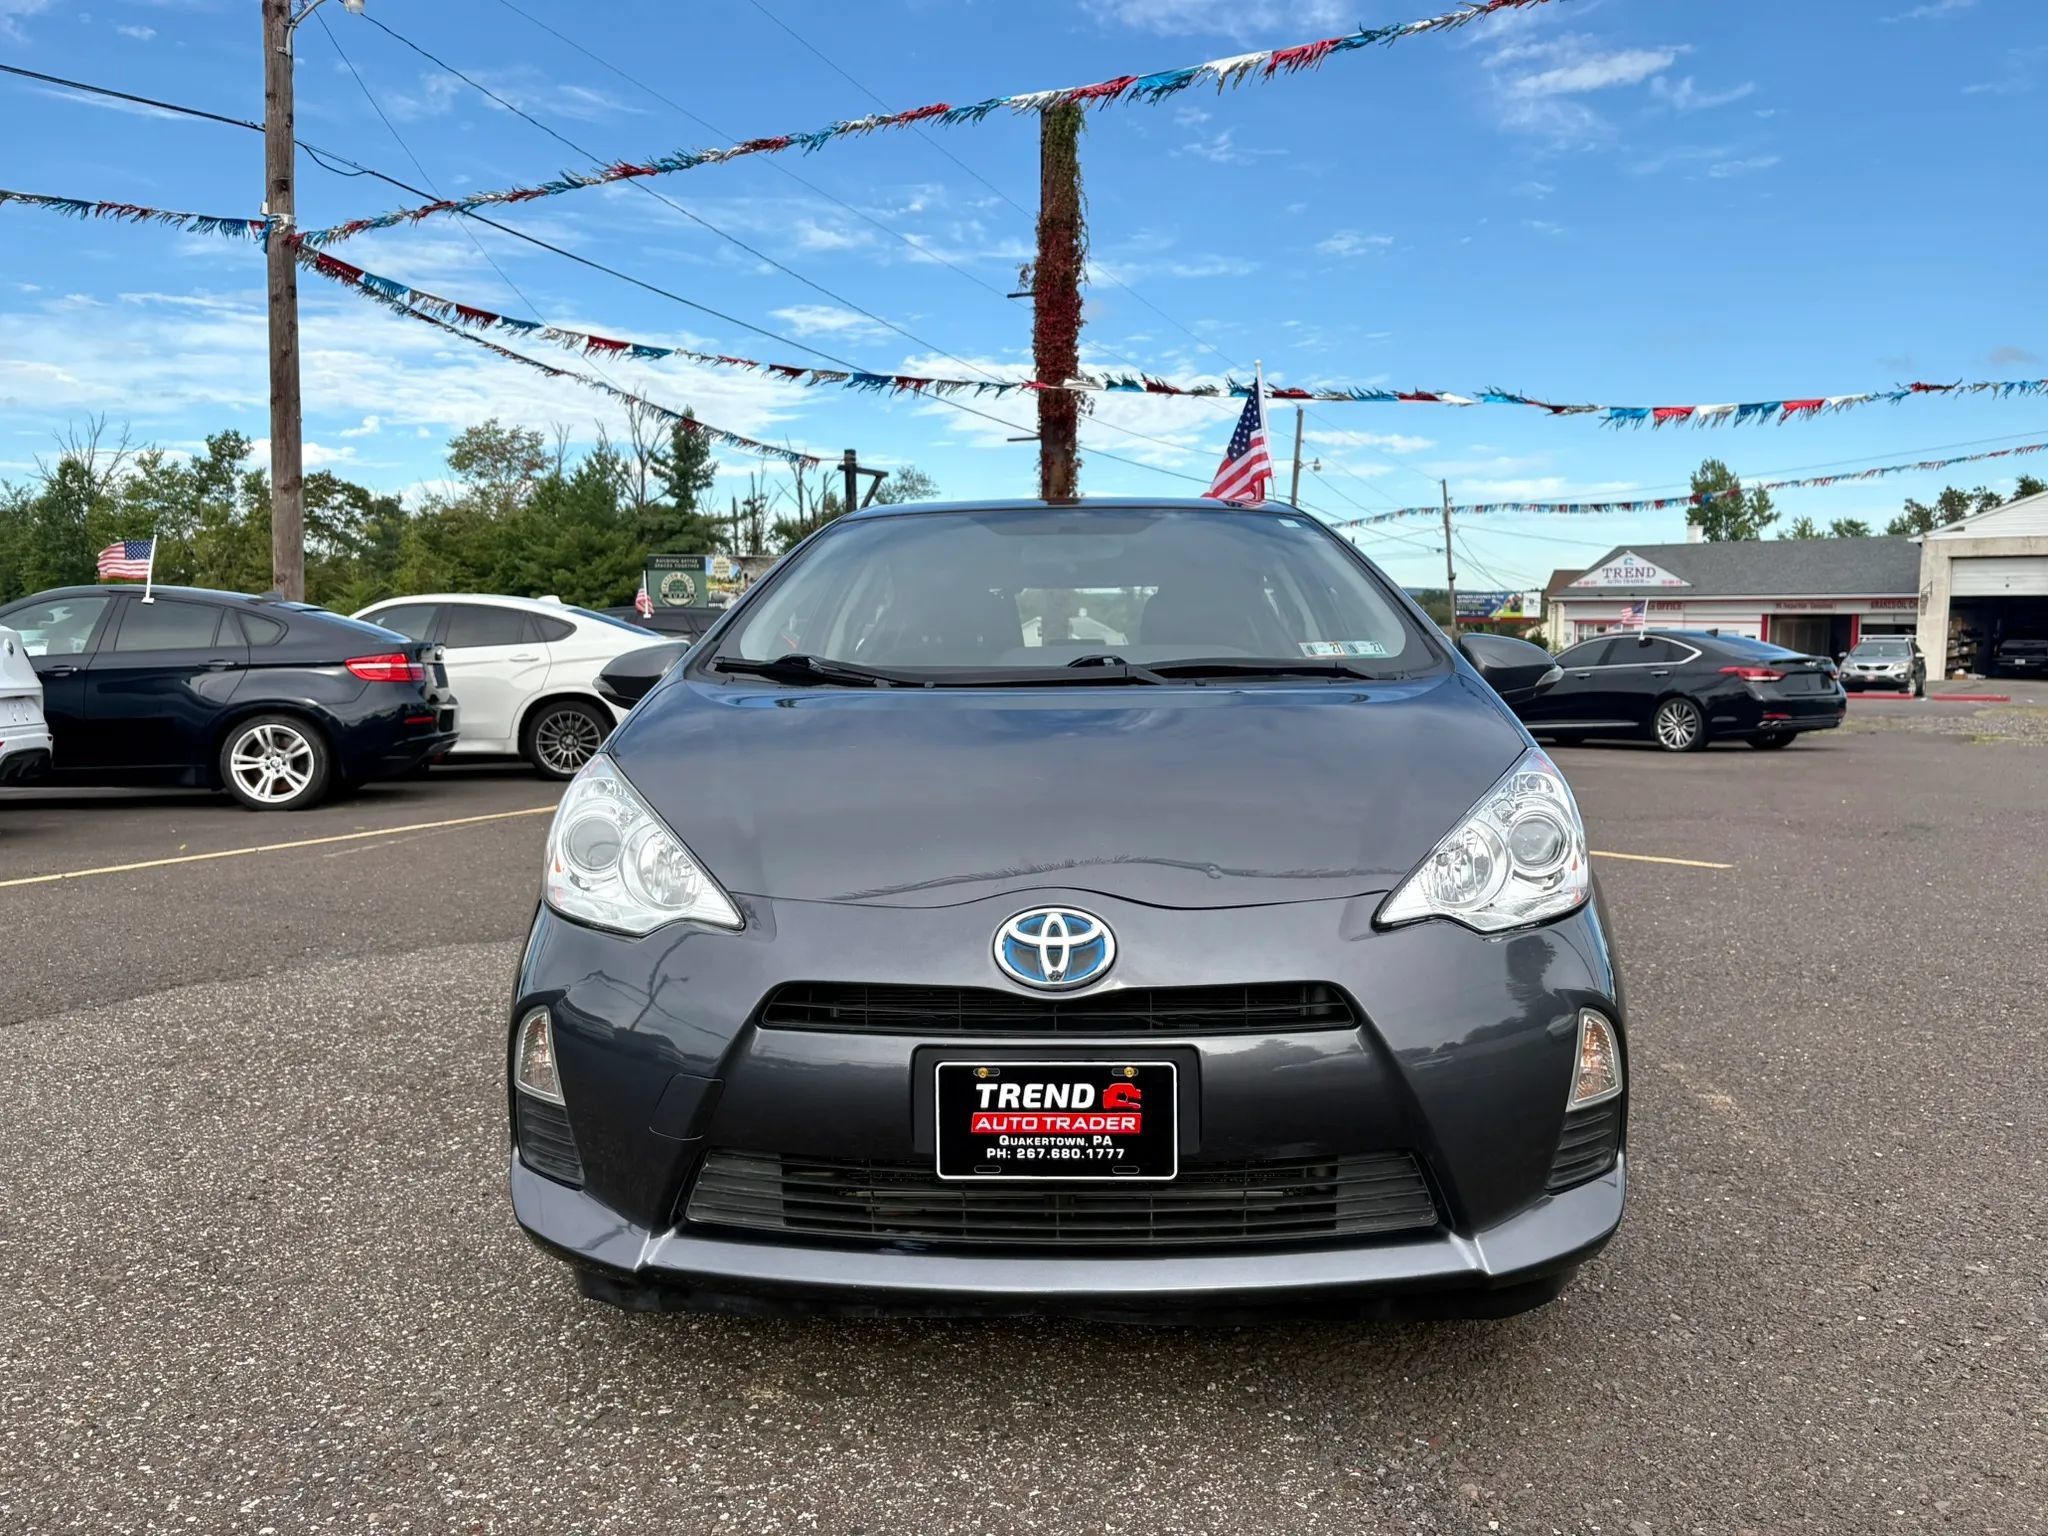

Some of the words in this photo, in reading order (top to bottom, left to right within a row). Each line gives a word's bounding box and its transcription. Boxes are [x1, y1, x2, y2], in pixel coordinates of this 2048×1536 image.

[1602, 567, 1656, 579] TREND
[1656, 600, 1682, 610] OFFICE
[975, 1083, 1095, 1109] TREND
[975, 1116, 1038, 1130] AUTO
[1041, 1116, 1136, 1130] TRADER
[1093, 1135, 1112, 1146] PA
[986, 1148, 1011, 1159] PH:
[1016, 1148, 1125, 1159] 267.680.1777
